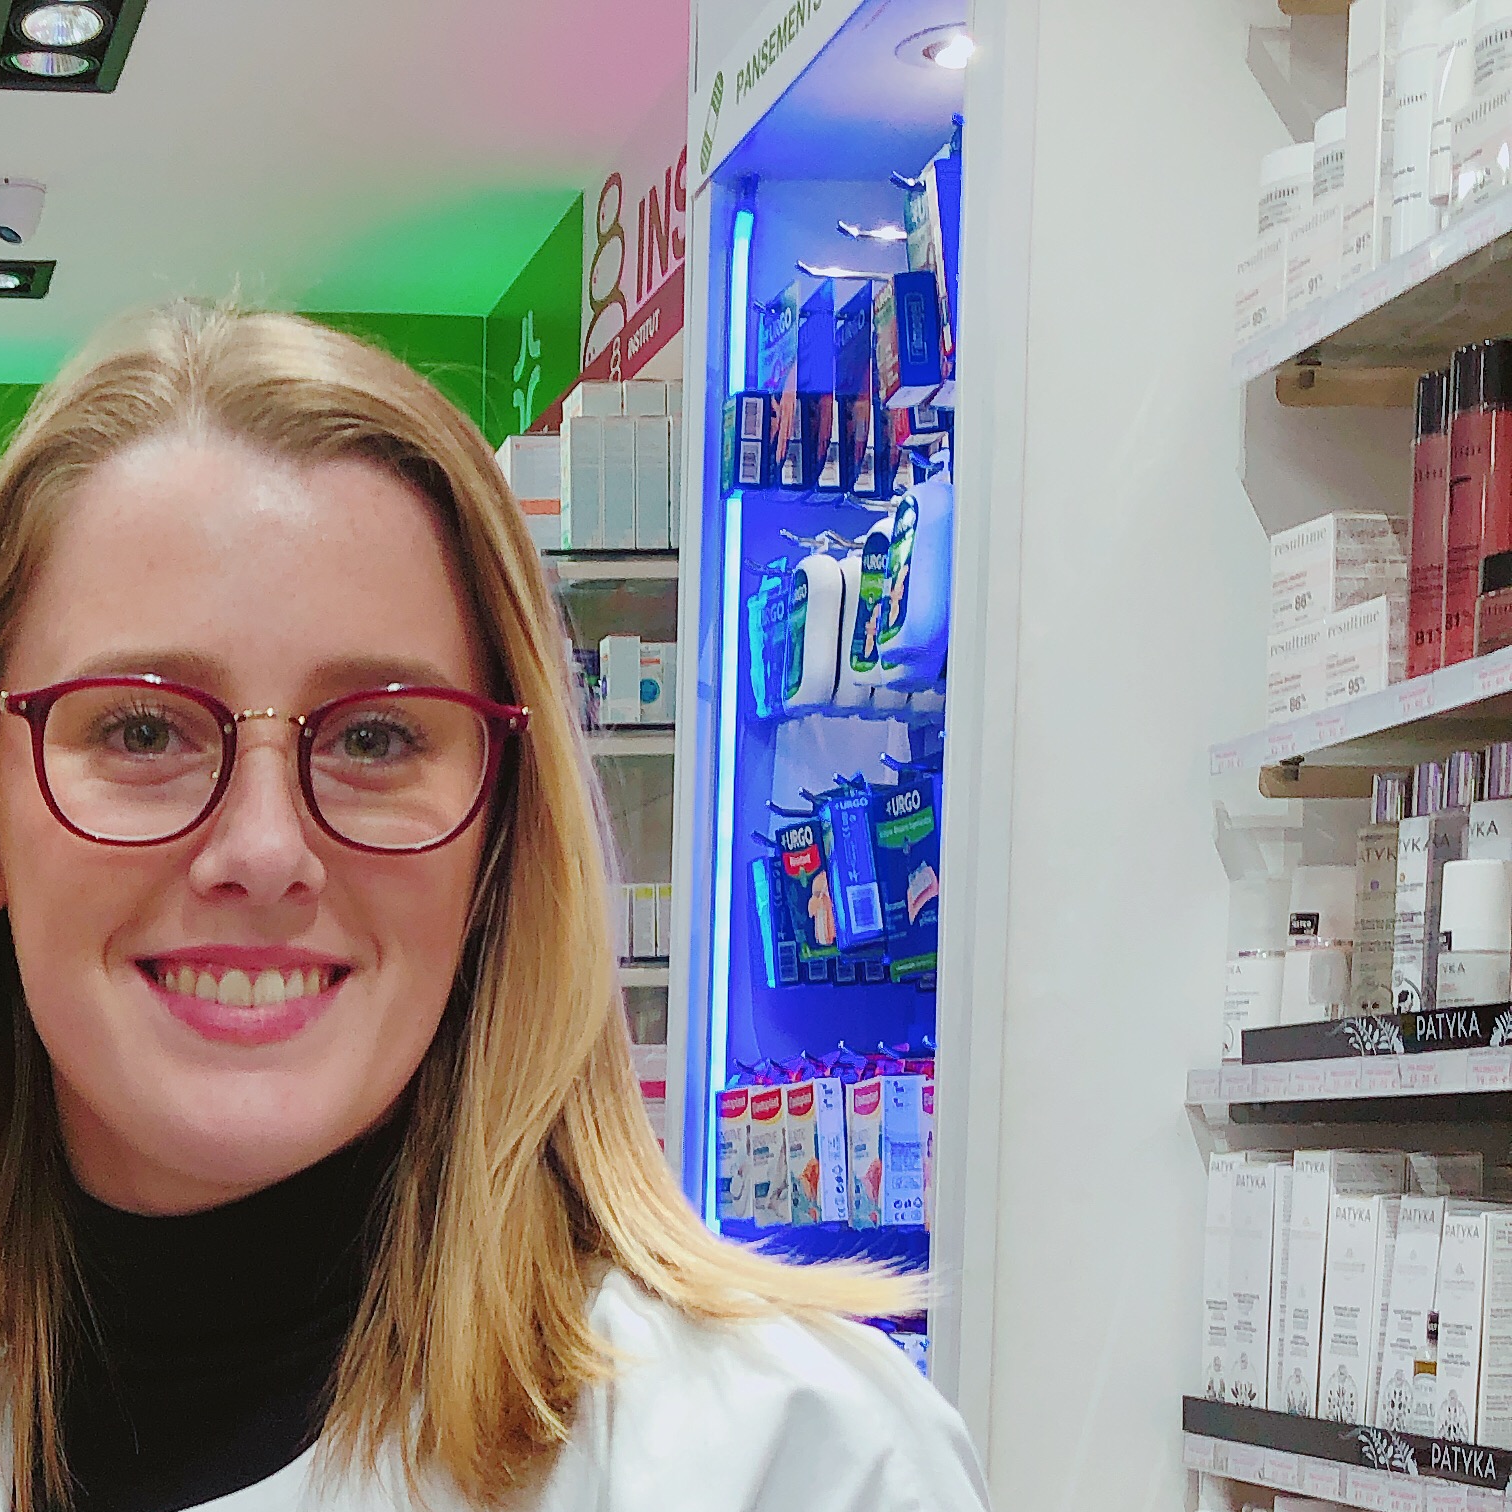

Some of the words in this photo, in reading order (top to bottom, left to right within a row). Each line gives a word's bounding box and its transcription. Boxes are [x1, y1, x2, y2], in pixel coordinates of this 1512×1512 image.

[626, 307, 662, 360] INSTITUT
[1273, 526, 1328, 557] resultime
[1326, 610, 1380, 638] resultime
[1269, 630, 1321, 658] resultime
[890, 790, 921, 816] URGO
[786, 826, 814, 850] URGO
[1416, 1009, 1481, 1042] PATYKA
[1335, 1206, 1371, 1222] PATYKA
[1402, 1207, 1436, 1224] PATYKA
[1445, 1223, 1480, 1239] PATYKA
[1431, 1442, 1497, 1481] PATYKA
